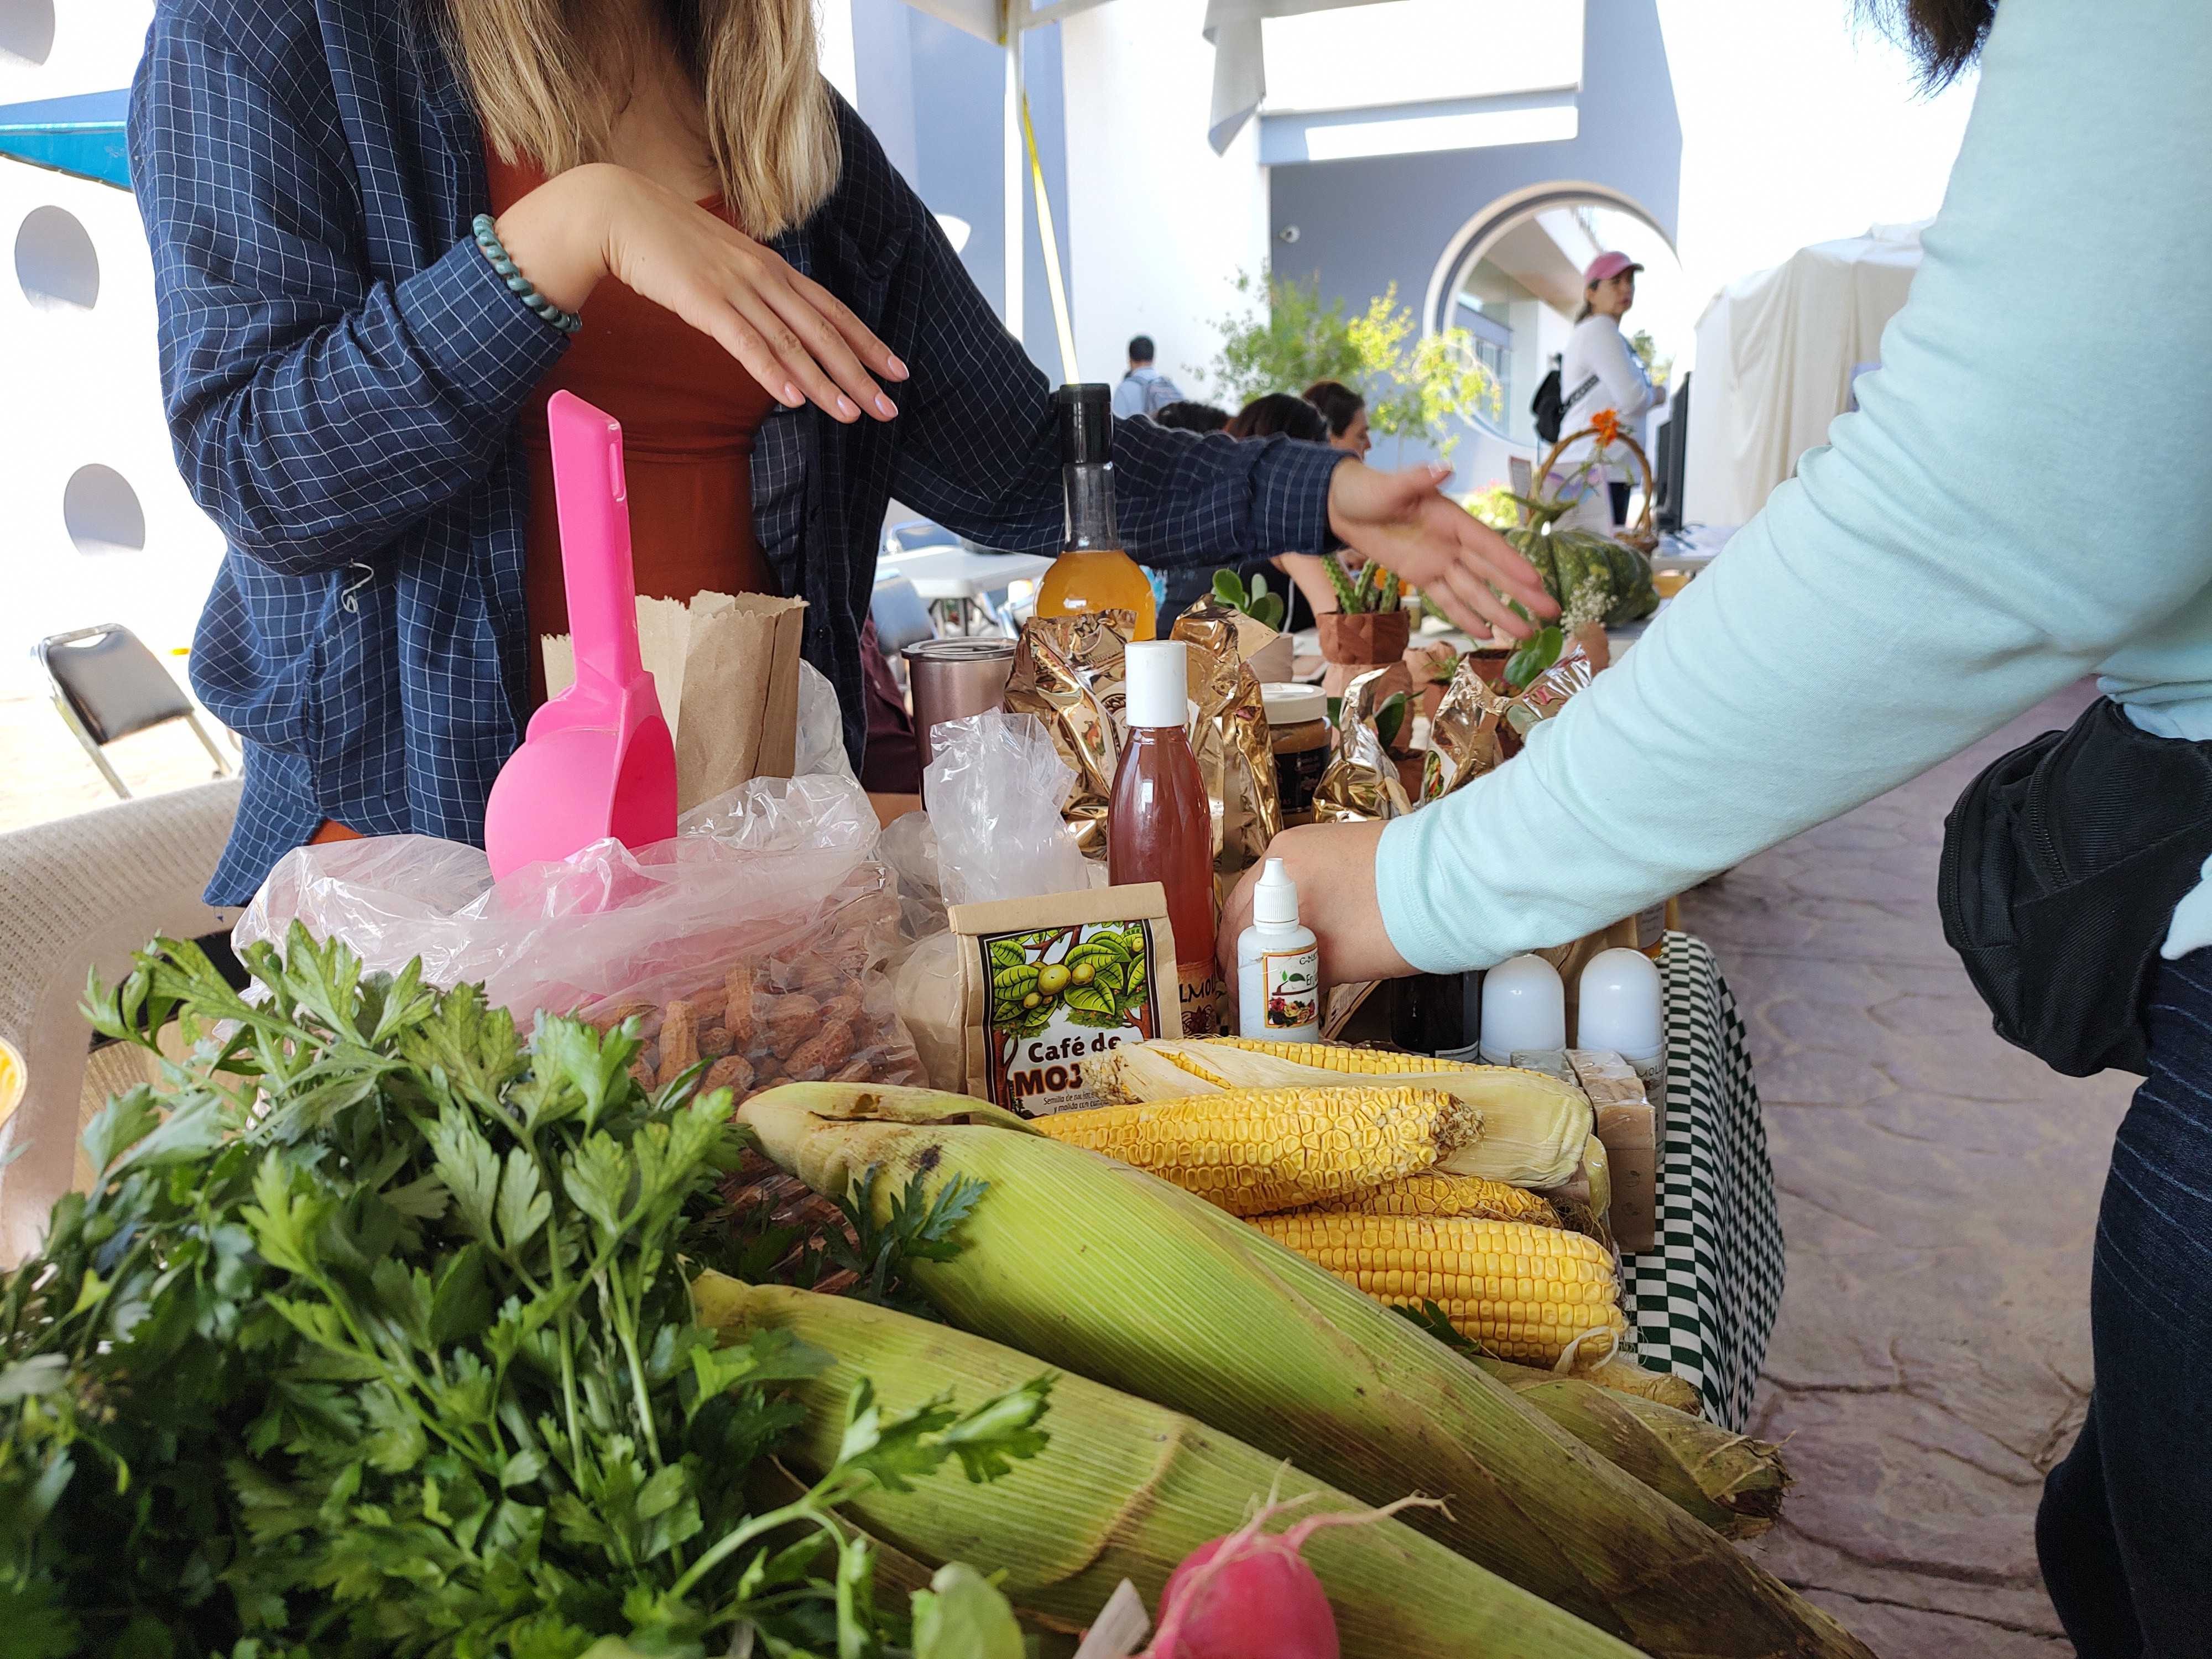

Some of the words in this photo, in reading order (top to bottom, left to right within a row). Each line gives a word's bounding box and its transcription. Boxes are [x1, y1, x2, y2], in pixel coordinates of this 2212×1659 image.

[1027, 1036, 1085, 1063] Café
[1091, 1032, 1121, 1052] de
[1013, 1062, 1083, 1098] MOJ
